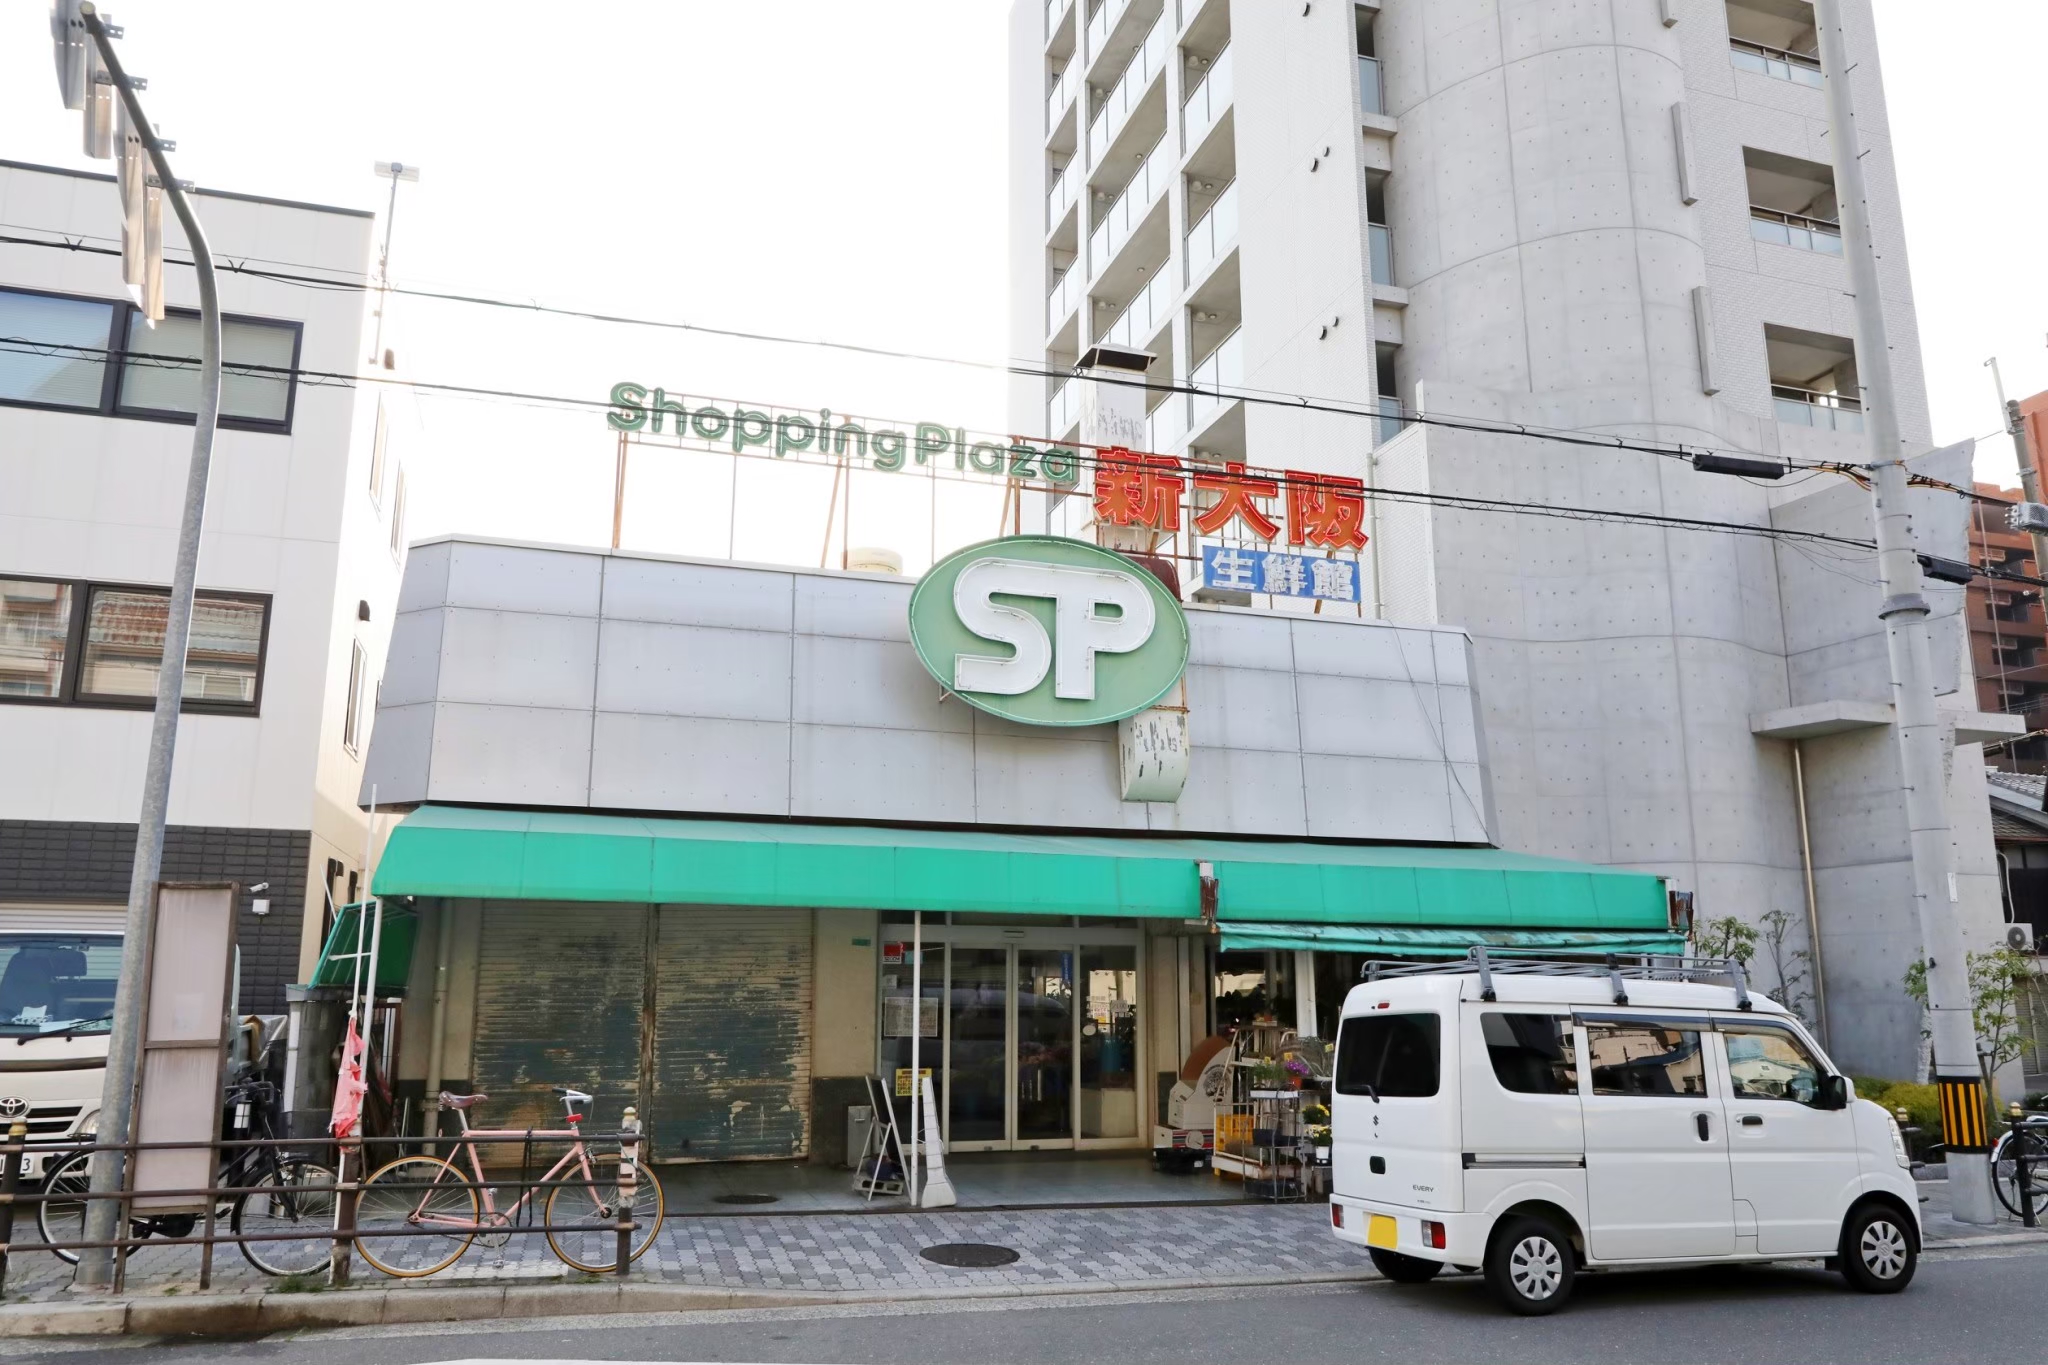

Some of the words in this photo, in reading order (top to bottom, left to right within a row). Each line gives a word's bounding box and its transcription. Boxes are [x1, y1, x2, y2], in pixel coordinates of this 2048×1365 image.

[606, 381, 907, 473] Shopping
[915, 421, 1078, 483] Plaza
[1093, 445, 1370, 553] 新大阪
[1211, 549, 1355, 600] 生鮮館
[953, 556, 1156, 700] SP
[1412, 1184, 1434, 1193] EVERY
